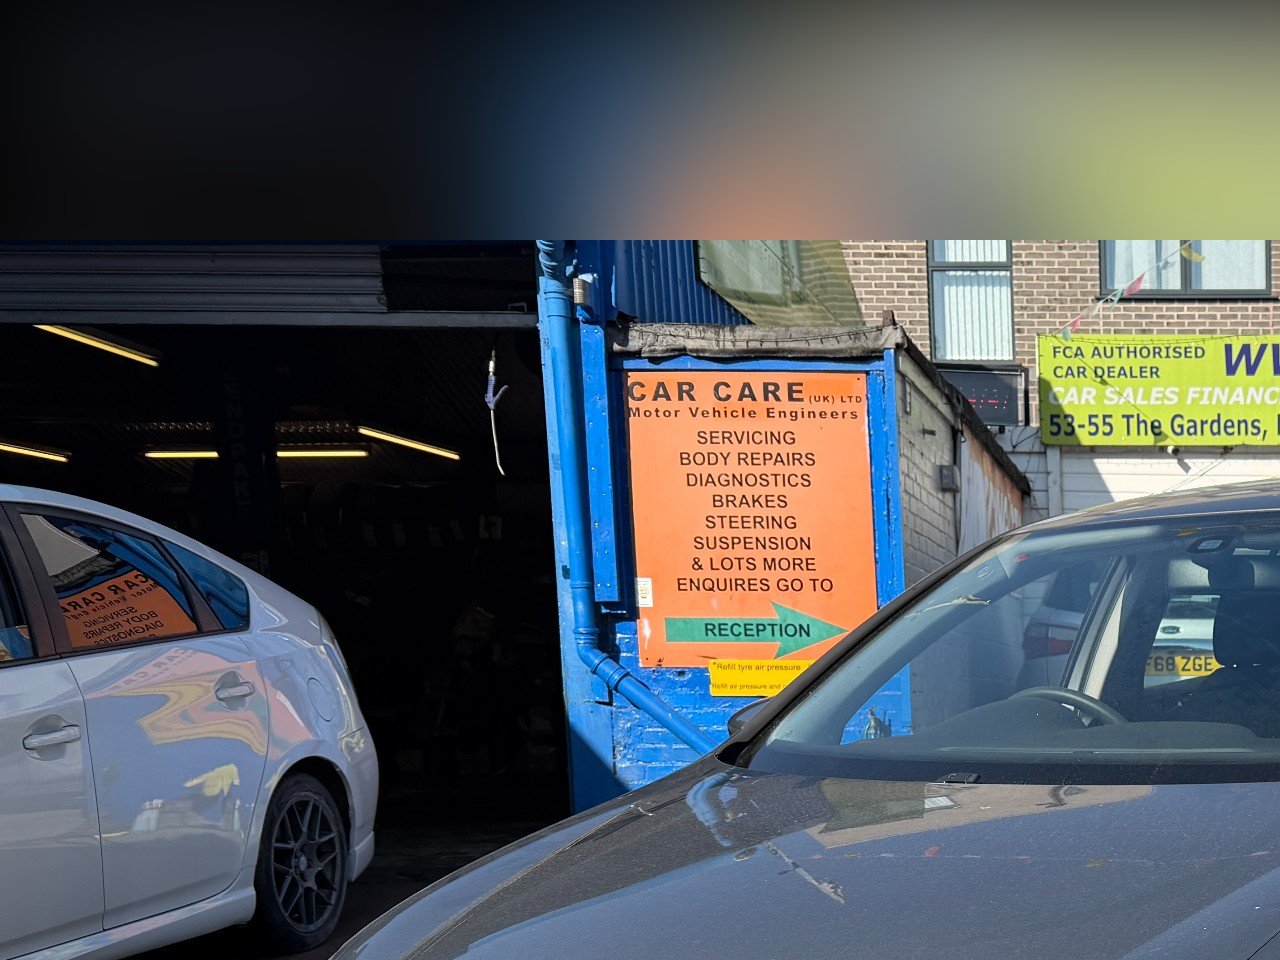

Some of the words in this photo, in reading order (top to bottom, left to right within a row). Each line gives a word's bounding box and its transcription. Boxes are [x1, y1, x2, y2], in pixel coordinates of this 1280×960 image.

[1053, 346, 1085, 359] FCA
[1091, 346, 1206, 359] AUTHORISED
[1053, 365, 1088, 379] CAR
[1094, 366, 1161, 379] DEALER
[627, 381, 697, 402] CAR
[713, 381, 805, 402] CARE
[809, 395, 835, 405] (UK)
[1049, 386, 1097, 406] CAR
[1103, 386, 1179, 406] SALES
[628, 407, 681, 418] Motor
[689, 407, 757, 419] Vehicle
[766, 407, 858, 421] Engineers
[1049, 414, 1114, 437] 53-55
[1122, 413, 1162, 436] The
[1171, 413, 1268, 441] Gardens,
[697, 430, 796, 445] SERVICING
[680, 452, 731, 466] BODY
[737, 452, 816, 467] REPAIRS
[686, 473, 812, 488] DIAGNOSTICS
[712, 494, 788, 508] BRAKES
[705, 515, 797, 530] STEERING
[693, 536, 811, 551] SUSPENSION
[691, 556, 704, 571] &
[709, 556, 757, 571] LOTS
[763, 557, 817, 571] MORE
[677, 578, 771, 593] ENQUIRES
[776, 578, 804, 592] GO
[809, 578, 834, 593] TO
[704, 622, 811, 638] RECEPTION
[1181, 656, 1214, 672] ZGE
